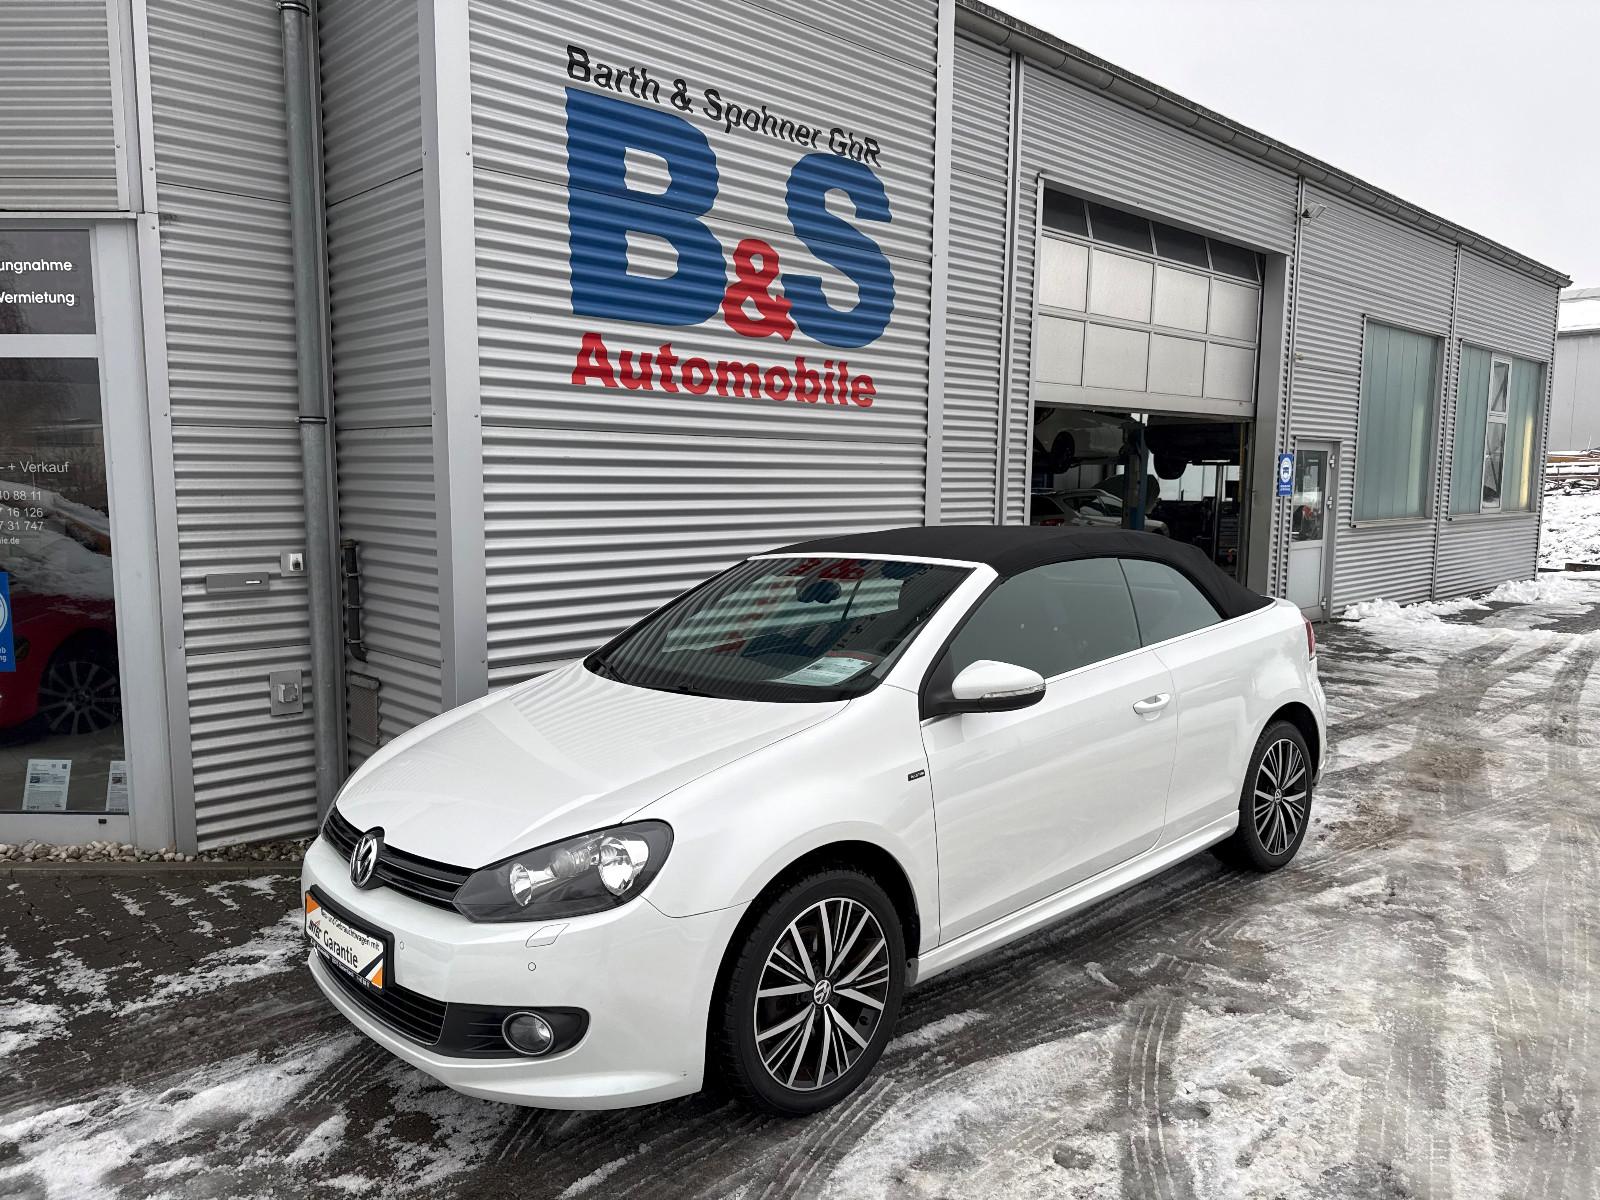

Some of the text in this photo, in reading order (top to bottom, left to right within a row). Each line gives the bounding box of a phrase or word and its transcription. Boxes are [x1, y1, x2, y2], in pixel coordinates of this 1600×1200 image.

[566, 44, 882, 168] Barth & Spohner GbR
[571, 331, 877, 409] Automobile
[20, 460, 71, 473] Verkauf
[13, 490, 27, 500] 88
[30, 490, 41, 500] 11
[7, 507, 20, 517] 16
[23, 507, 44, 518] 126
[7, 520, 20, 531] 31
[23, 521, 44, 531] 747
[323, 930, 359, 969] Garantie
